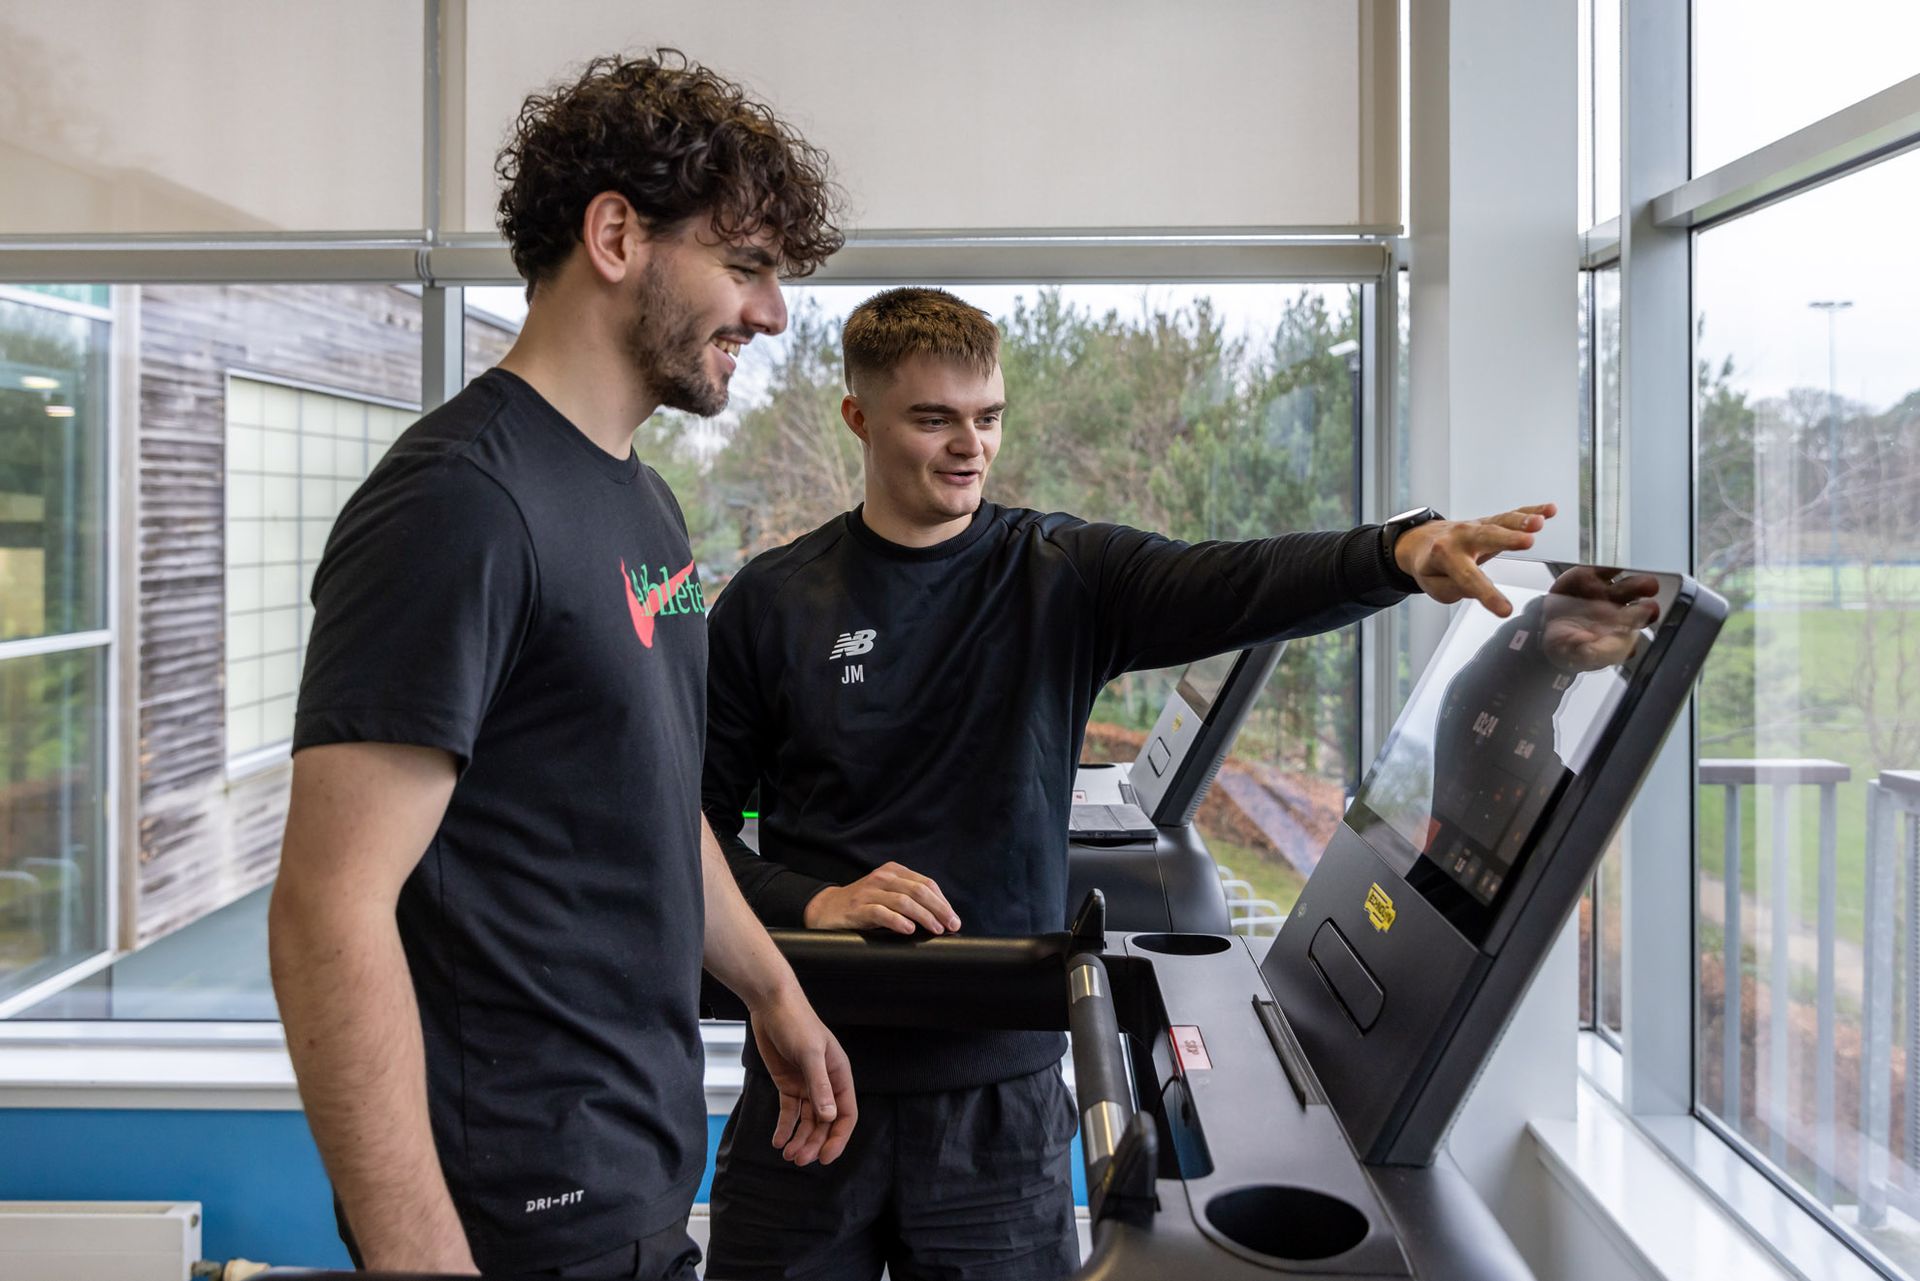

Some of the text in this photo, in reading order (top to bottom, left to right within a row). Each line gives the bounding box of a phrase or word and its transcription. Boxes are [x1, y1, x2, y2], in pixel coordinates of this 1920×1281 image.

[829, 628, 877, 660] NB
[841, 664, 864, 684] JM
[525, 1189, 584, 1213] DRI-FIT
